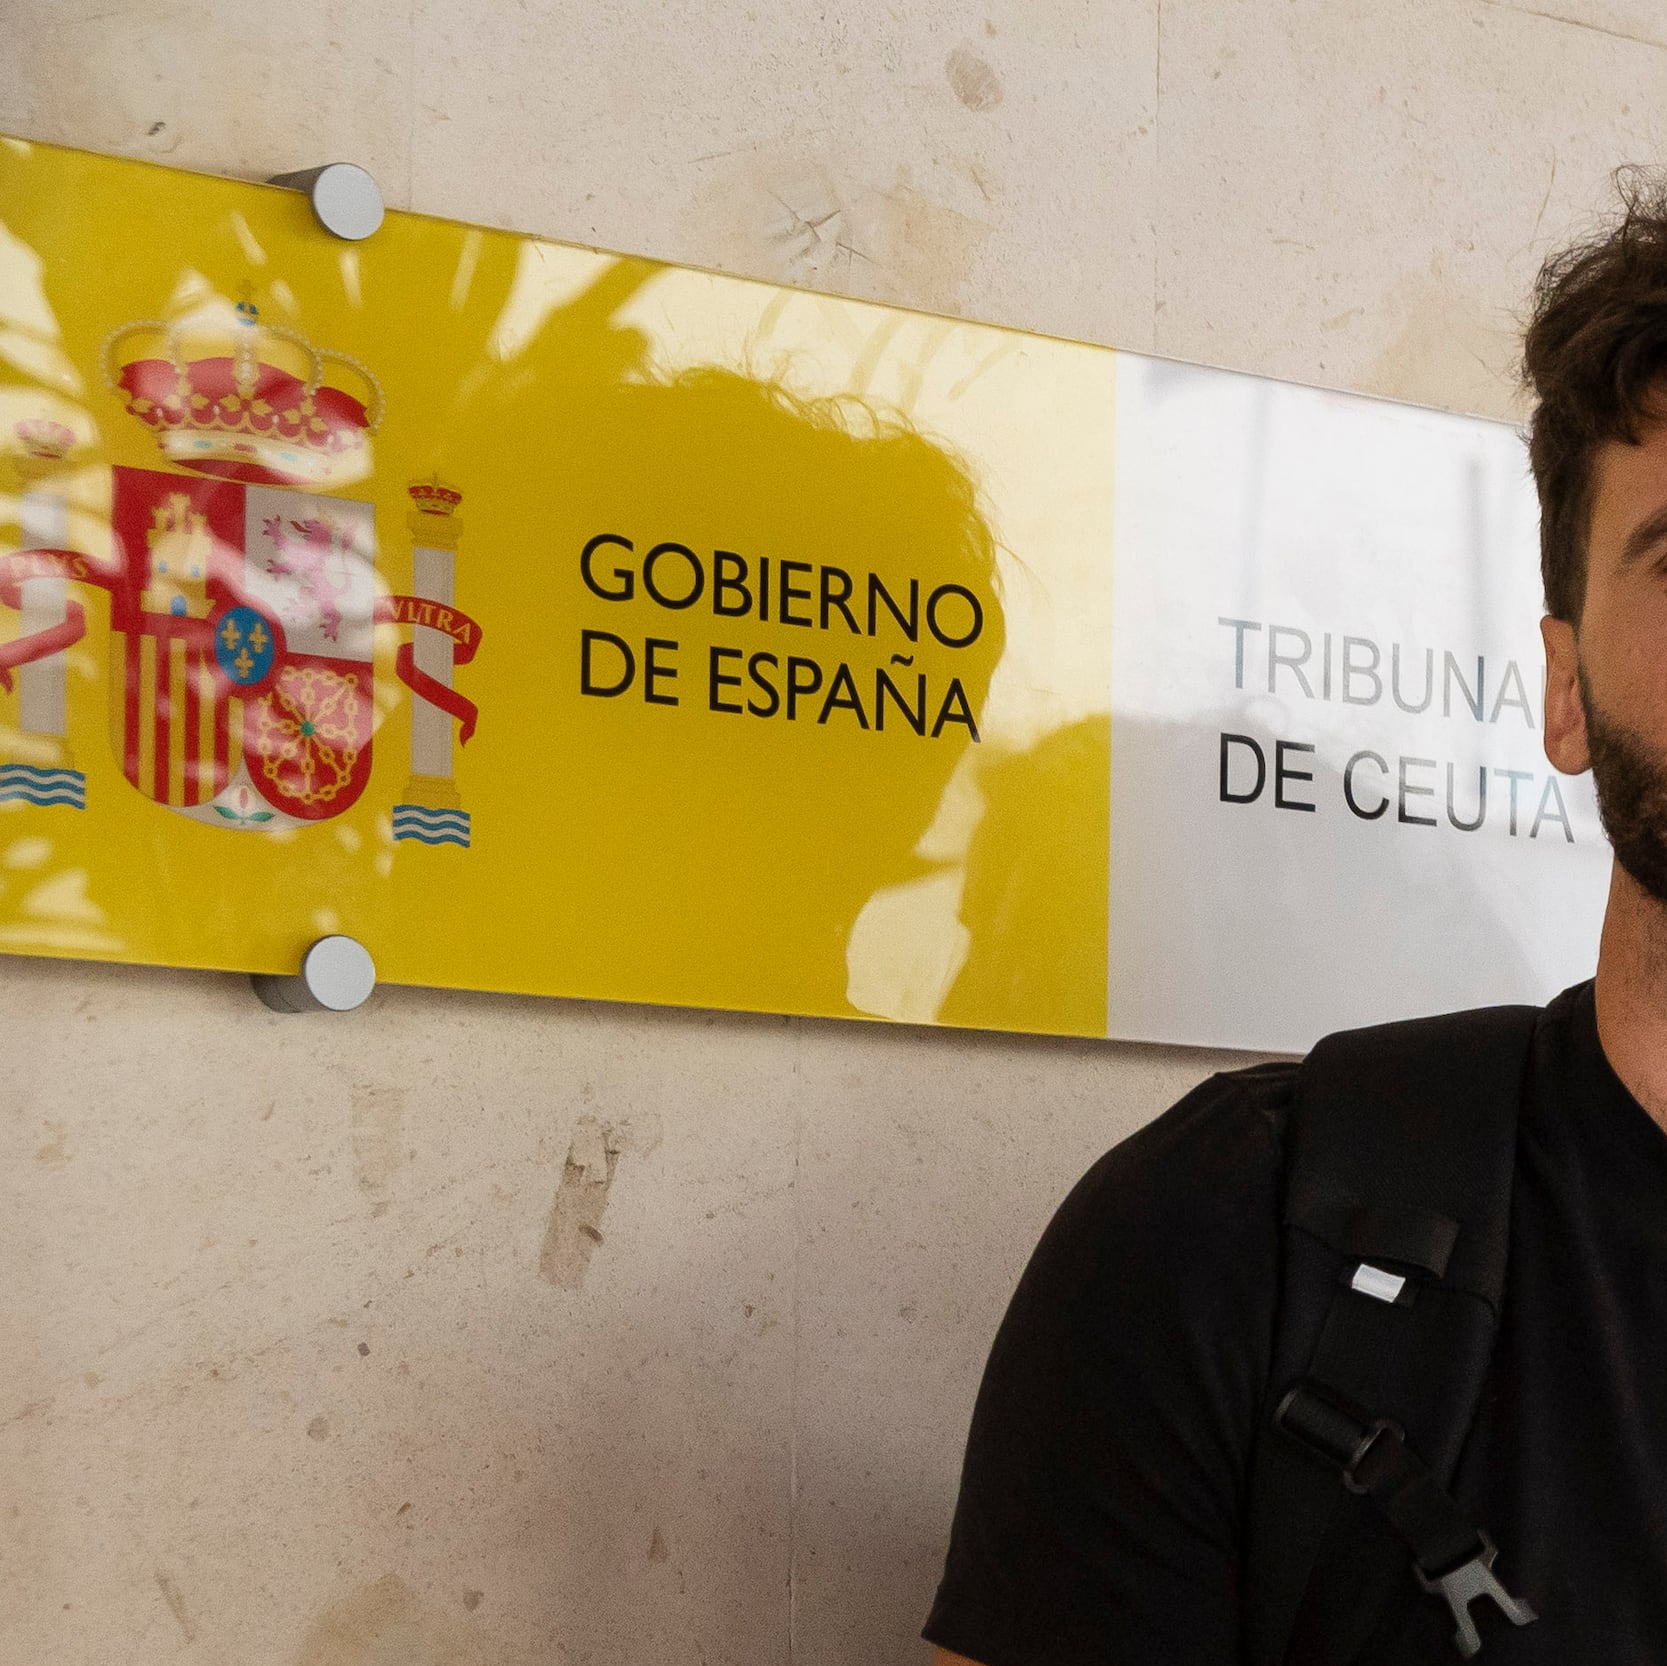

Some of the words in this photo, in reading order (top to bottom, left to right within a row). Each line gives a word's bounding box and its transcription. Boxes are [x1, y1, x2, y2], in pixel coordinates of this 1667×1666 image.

[387, 600, 472, 645] VLTRA
[580, 533, 984, 649] GOBIERNO
[581, 629, 679, 706] DE
[709, 646, 981, 744] ESPAÑA
[1217, 616, 1546, 730] TRIBUNA
[1220, 732, 1316, 813] DE
[1344, 749, 1575, 844] CEUTA
